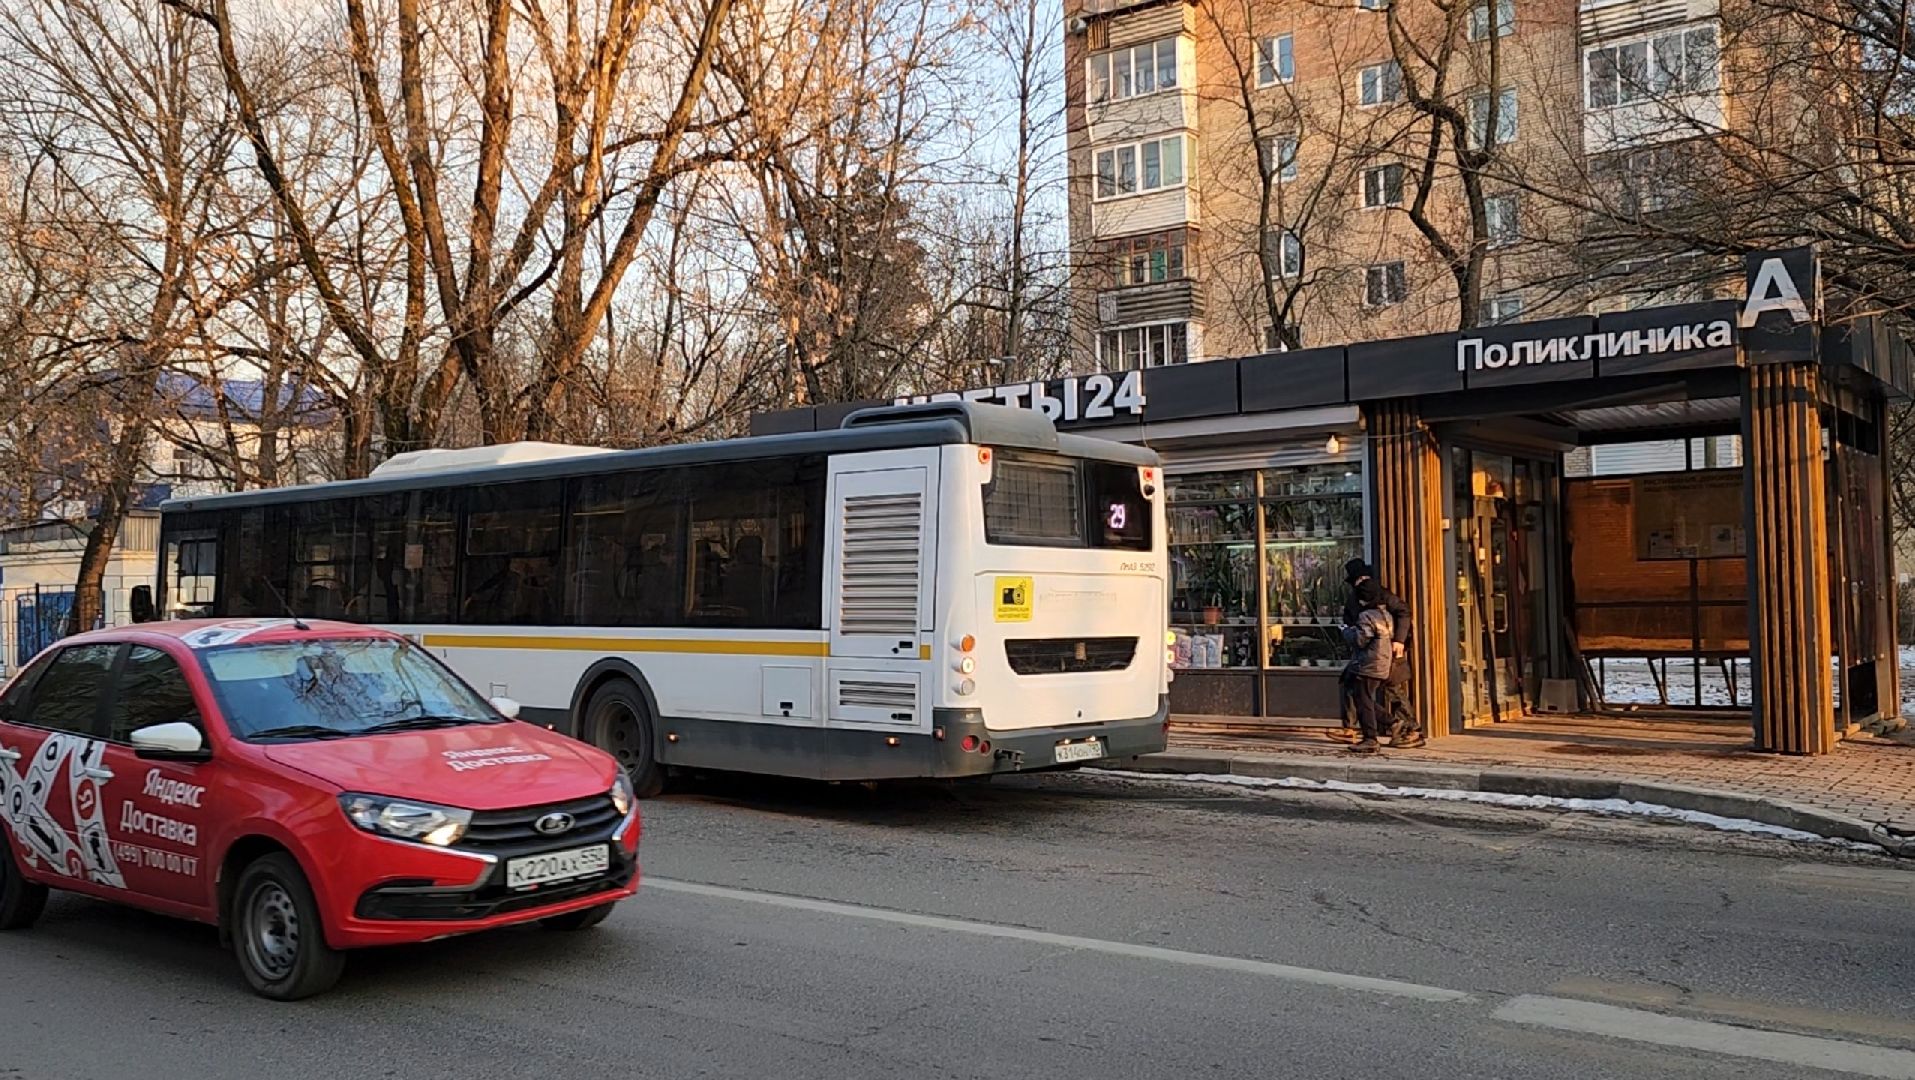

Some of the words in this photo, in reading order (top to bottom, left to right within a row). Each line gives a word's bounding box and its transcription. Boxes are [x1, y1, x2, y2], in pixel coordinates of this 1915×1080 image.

[1740, 257, 1811, 329] А
[1456, 319, 1733, 371] Поликлиника
[1109, 503, 1126, 529] 29
[446, 753, 553, 772] Доставка
[142, 767, 206, 808] Яндекс
[120, 800, 198, 847] Доставка
[143, 848, 166, 869] 700
[166, 854, 181, 874] 00
